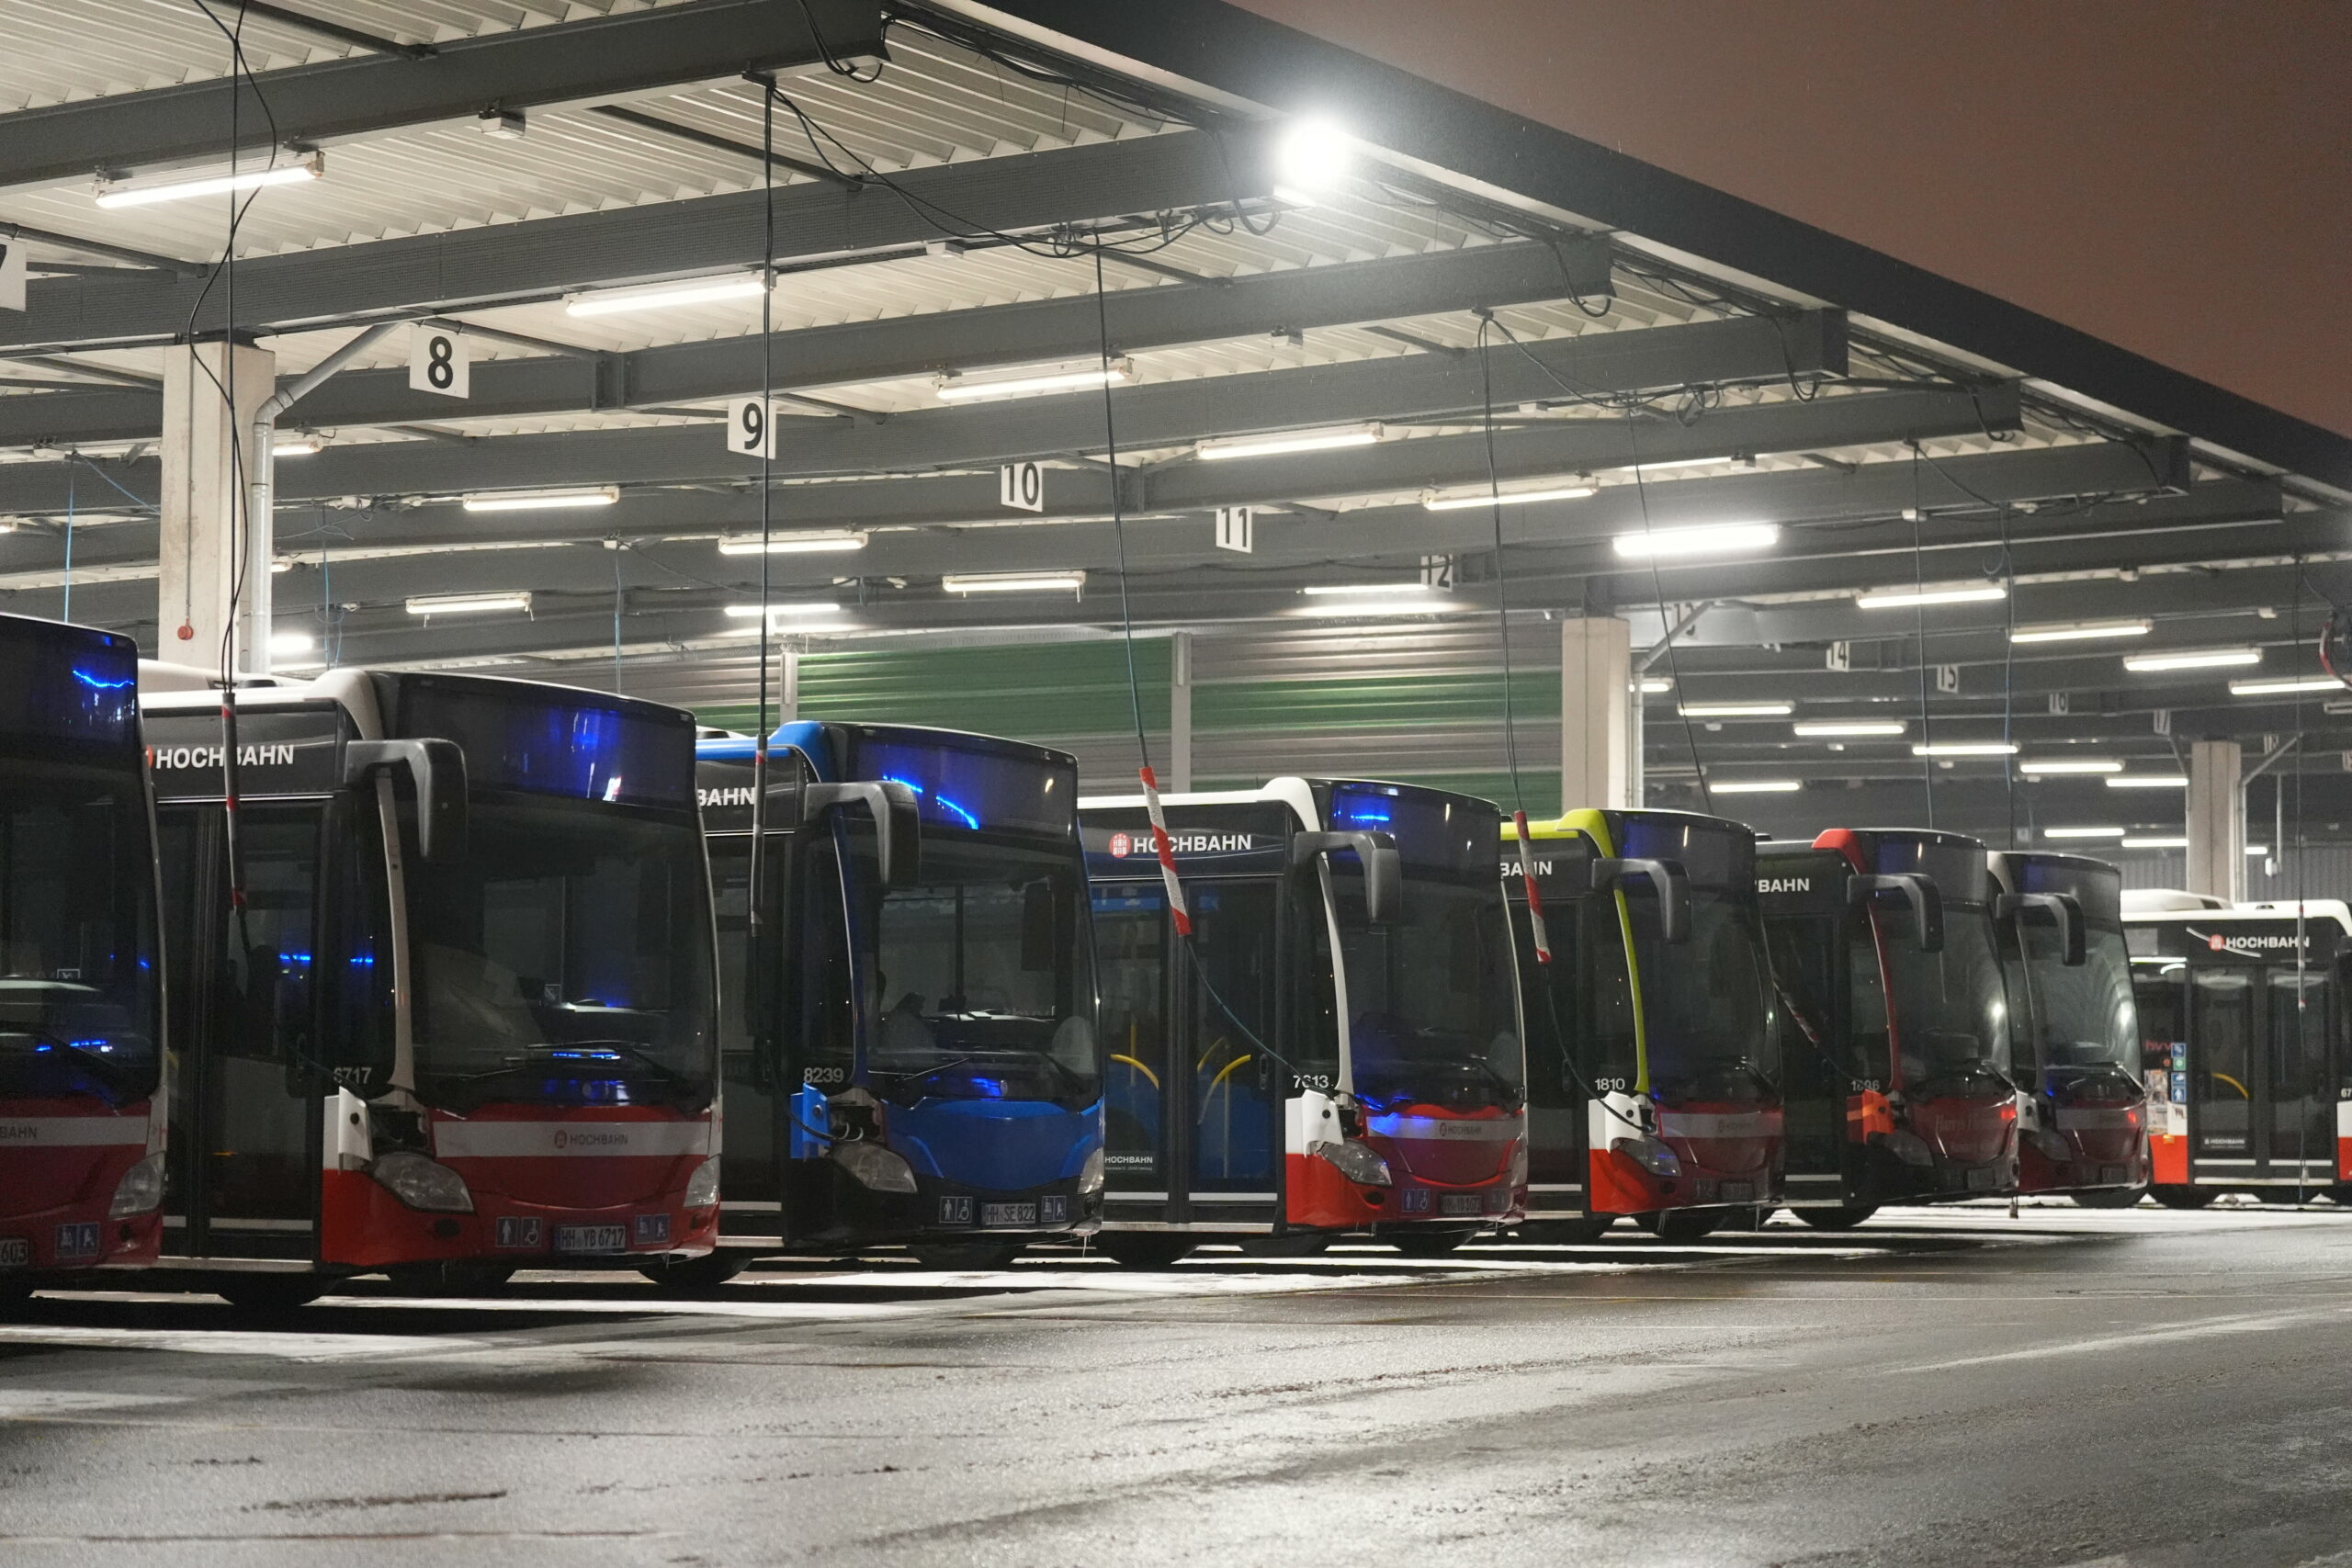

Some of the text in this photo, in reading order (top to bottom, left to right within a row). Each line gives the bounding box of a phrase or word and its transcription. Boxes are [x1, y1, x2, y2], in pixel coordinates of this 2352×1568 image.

[428, 336, 453, 389] 8
[742, 402, 763, 450] 9
[1004, 462, 1039, 506] 10
[1221, 508, 1247, 547] 11
[1427, 555, 1450, 588] 12
[1829, 642, 1848, 668] 14
[1941, 666, 1957, 689] 15
[1754, 878, 1810, 893] BAHN
[333, 1066, 371, 1084] 6717
[804, 1067, 844, 1083] 8239
[1594, 1077, 1625, 1090] 1810
[571, 1134, 628, 1145] HOCHBAHN
[986, 1206, 999, 1223] HH
[561, 1227, 625, 1248] HH YB 6717
